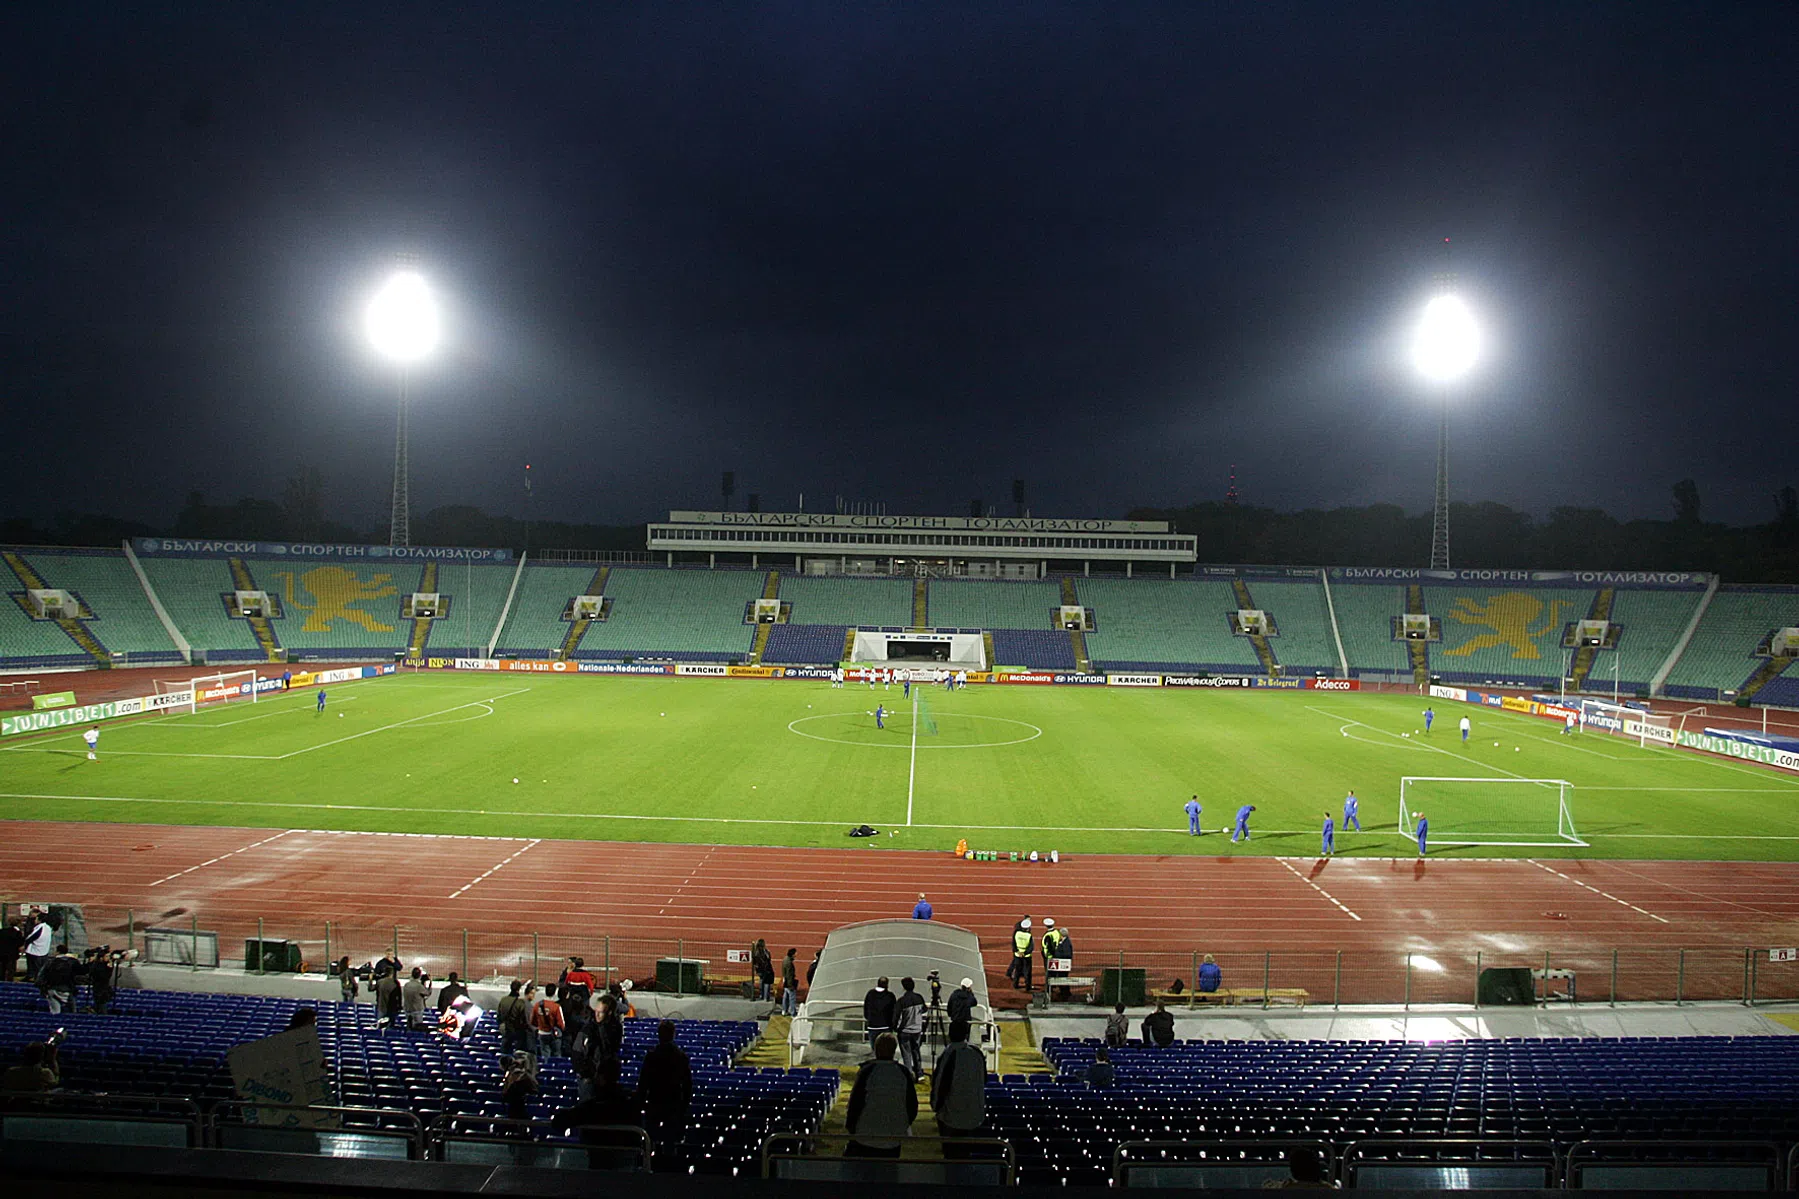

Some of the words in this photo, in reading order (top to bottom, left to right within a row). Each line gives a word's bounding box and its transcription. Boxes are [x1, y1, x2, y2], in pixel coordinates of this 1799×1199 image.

[721, 513, 835, 526] БЪЛГАРСКИ
[851, 515, 947, 528] СПОРТЕН
[963, 518, 1112, 531] ТОТАЛИЗАТОР
[163, 540, 257, 553] БЪЛГАРСКИ
[291, 544, 364, 556] СПОРТЕН
[388, 547, 490, 560] ТОТАЛИЗАТОР
[1345, 568, 1420, 579] БЪЛГАРСКИ
[1460, 569, 1528, 580] СПОРТЕН
[1573, 571, 1690, 583] ТОТАЛИЗАТОР
[460, 660, 480, 668] ING
[509, 661, 530, 671] alles
[532, 661, 549, 671] kan
[329, 668, 345, 681] ING
[1009, 674, 1051, 682] McDonald's
[1067, 675, 1105, 683] HYUNDAI
[1314, 679, 1350, 690] Adecco
